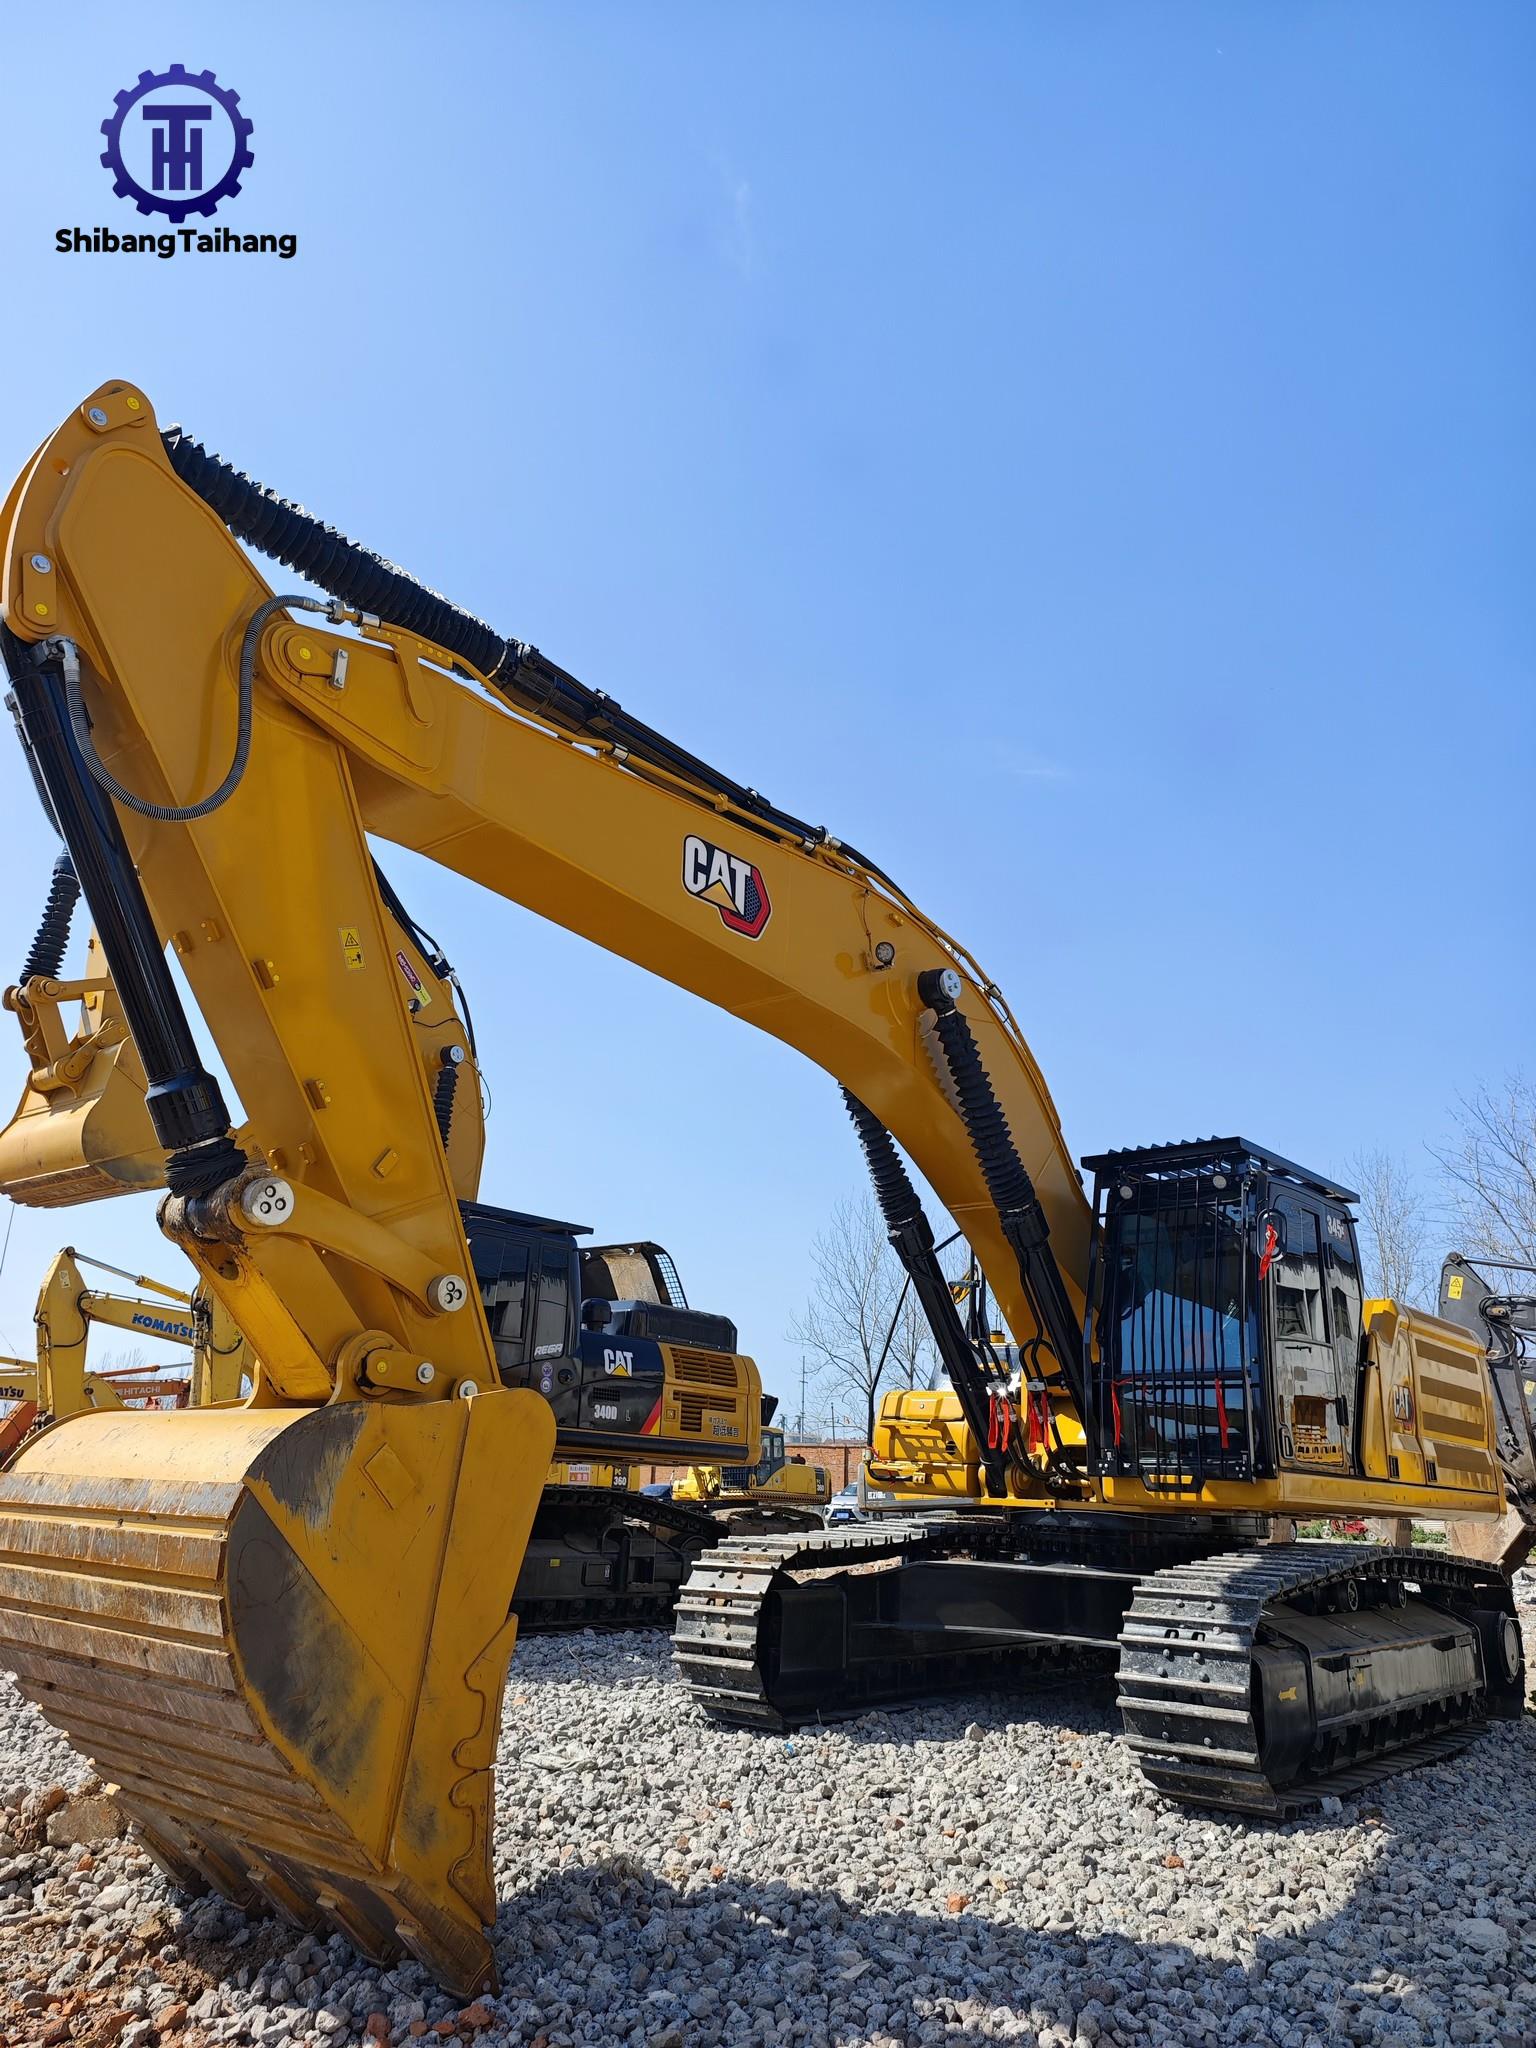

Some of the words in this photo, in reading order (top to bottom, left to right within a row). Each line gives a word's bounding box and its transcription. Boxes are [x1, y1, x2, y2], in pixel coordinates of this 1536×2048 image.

[684, 836, 751, 915] CAT
[603, 1348, 634, 1377] CAT
[123, 1385, 161, 1395] HITACHI
[1392, 1384, 1409, 1420] CAT
[594, 1404, 618, 1420] 340D
[614, 1468, 622, 1476] PC
[613, 1476, 627, 1486] 360
